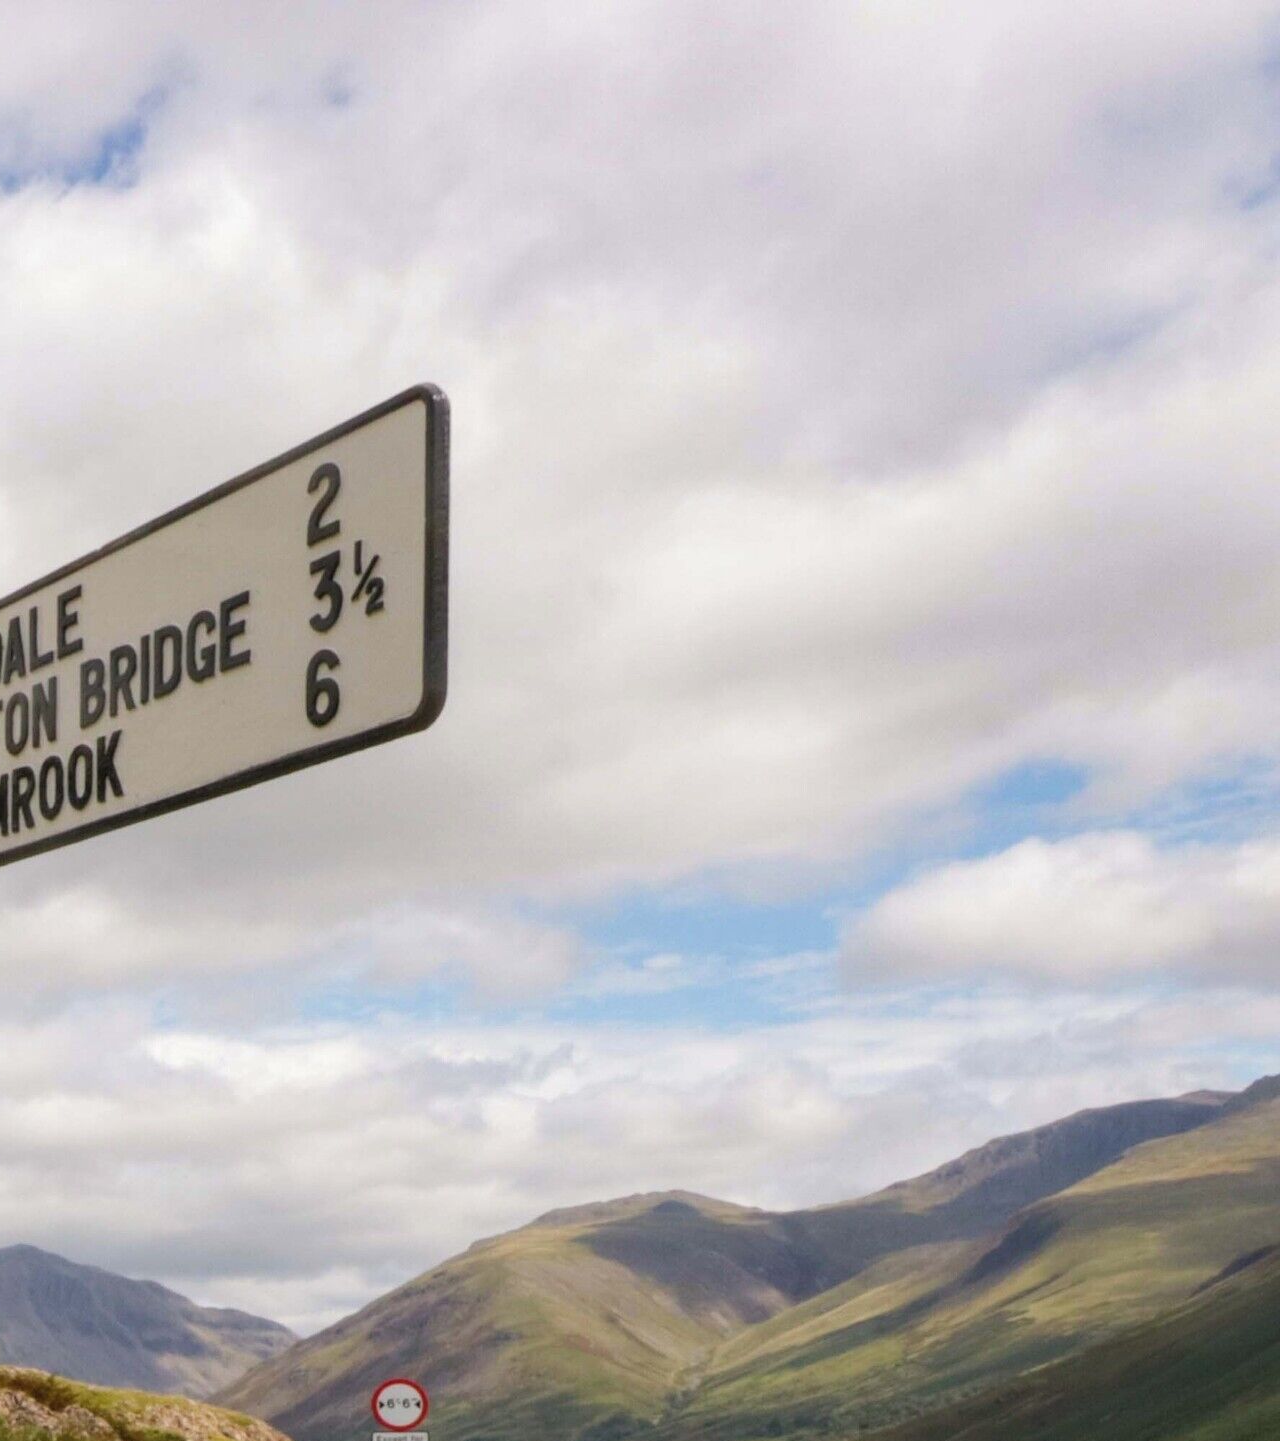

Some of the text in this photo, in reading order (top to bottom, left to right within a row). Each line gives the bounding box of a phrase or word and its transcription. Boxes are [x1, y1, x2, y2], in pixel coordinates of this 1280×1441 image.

[306, 462, 342, 550] 2
[79, 590, 252, 731] BRIDGE
[305, 648, 342, 730] 6
